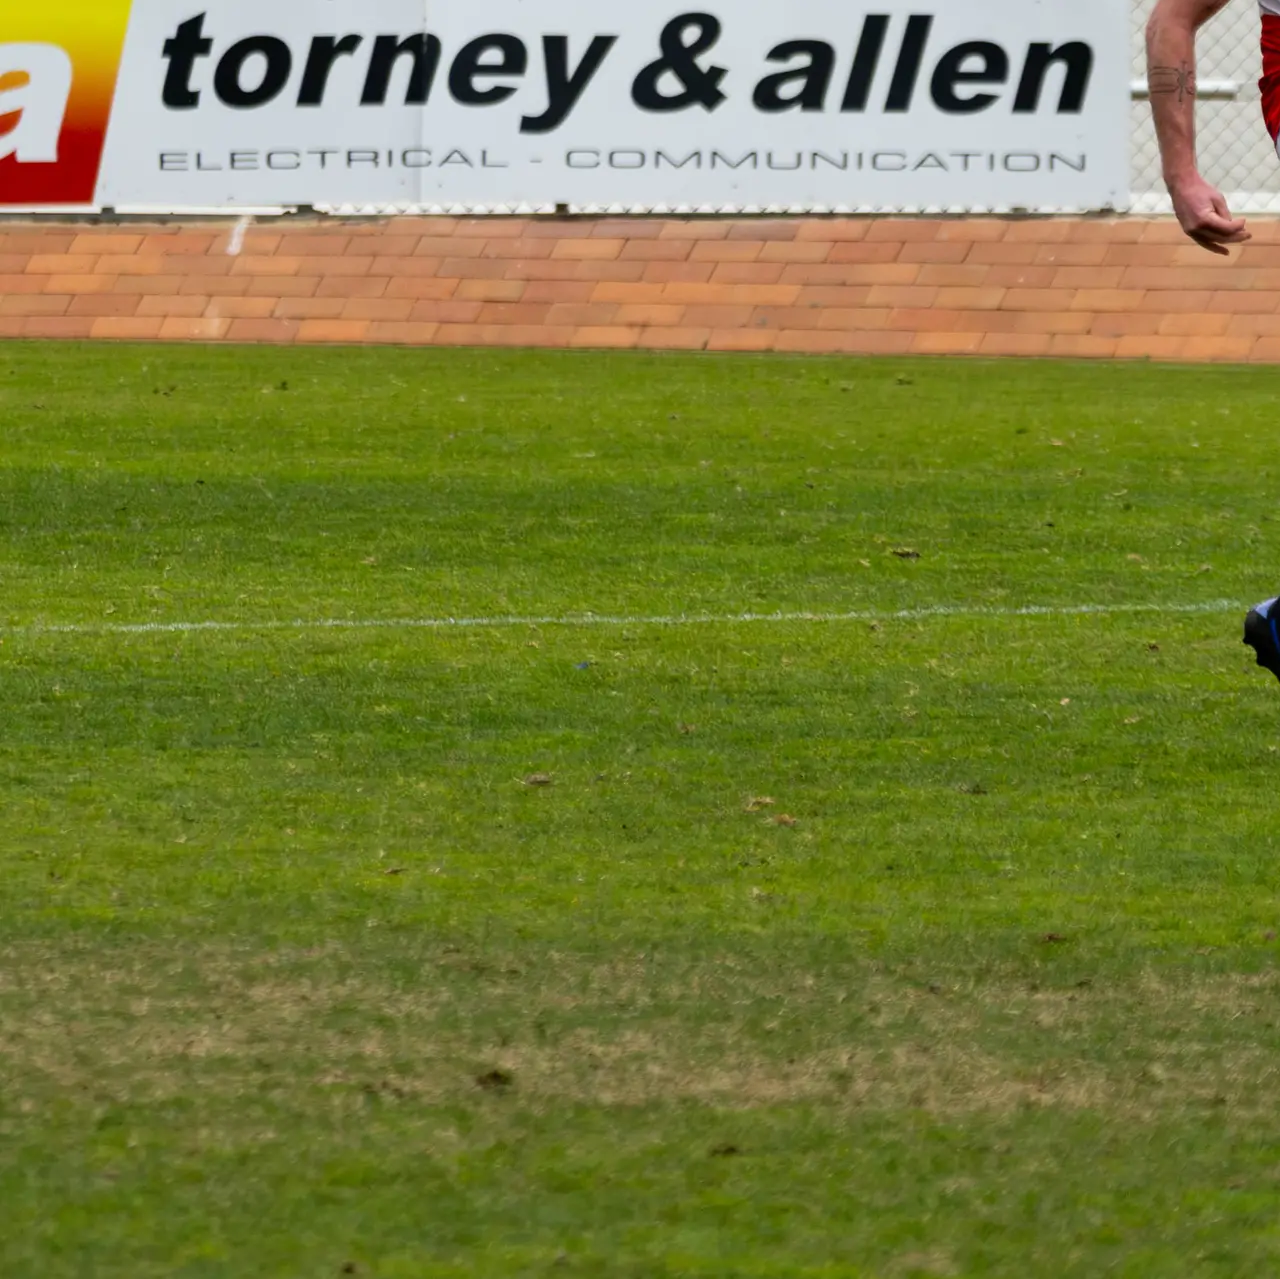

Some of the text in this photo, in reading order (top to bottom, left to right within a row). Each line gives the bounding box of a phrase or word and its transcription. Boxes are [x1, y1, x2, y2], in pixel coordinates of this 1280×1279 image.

[161, 11, 1095, 135] torney & allen
[158, 148, 509, 172] ELECTRICAL
[565, 149, 1088, 173] COMMUNICATION
